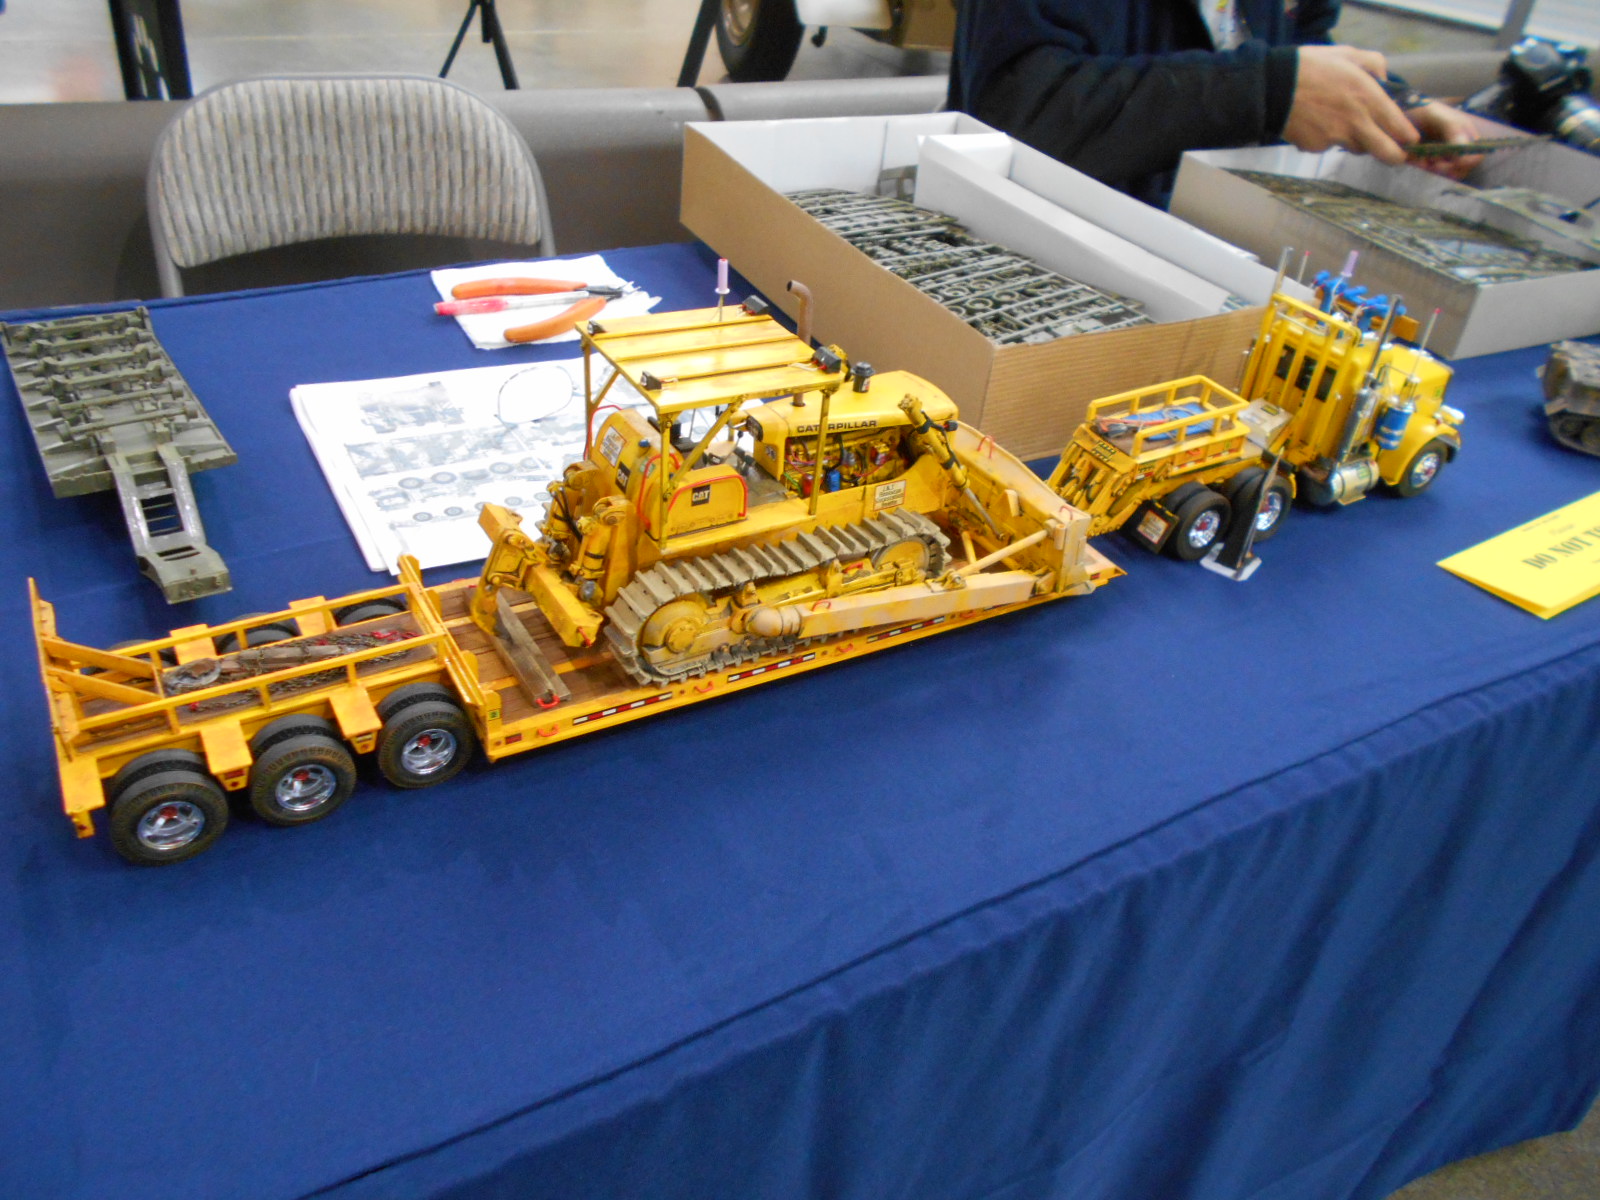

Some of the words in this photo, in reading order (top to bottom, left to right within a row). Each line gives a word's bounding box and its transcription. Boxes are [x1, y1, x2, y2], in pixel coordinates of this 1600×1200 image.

[796, 420, 877, 433] CATRPILLAR
[692, 489, 710, 502] CAT
[1521, 553, 1558, 570] DO
[1547, 536, 1593, 557] NOT
